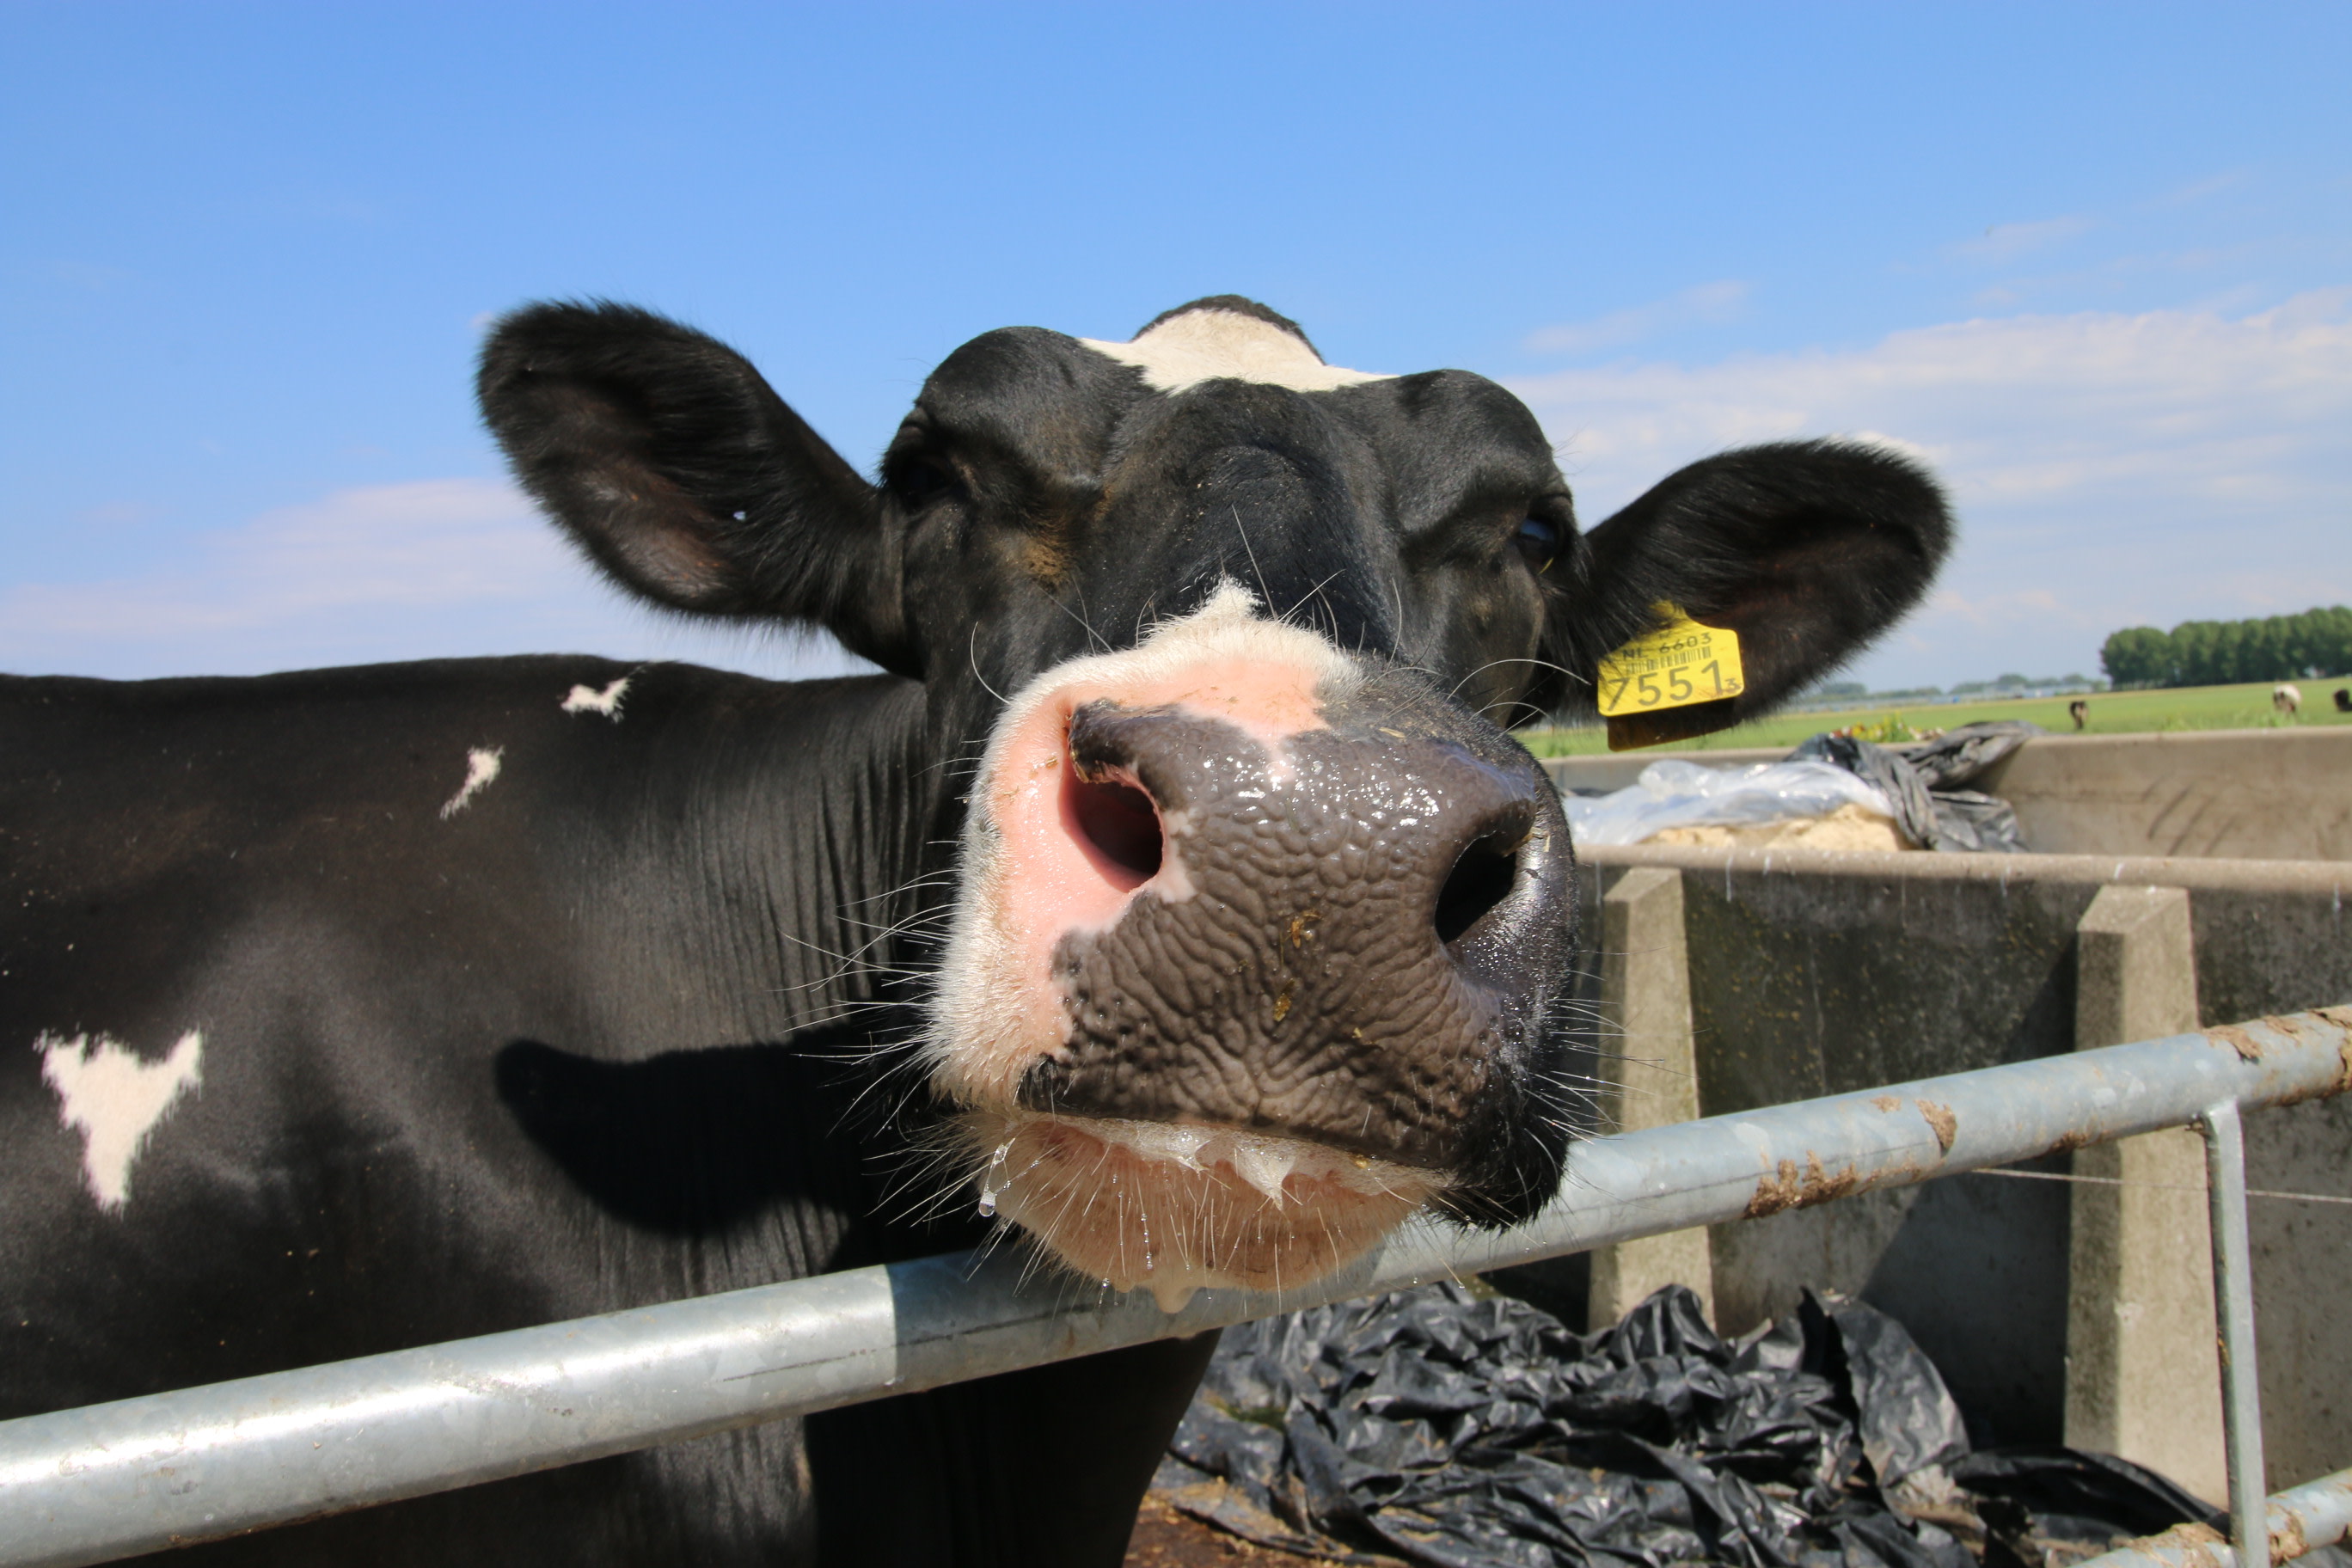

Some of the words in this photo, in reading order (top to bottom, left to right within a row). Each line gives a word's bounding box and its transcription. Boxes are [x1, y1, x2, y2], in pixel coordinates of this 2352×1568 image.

[1622, 647, 1648, 660] NL
[1659, 632, 1712, 653] 6603
[1608, 659, 1724, 712] 7551
